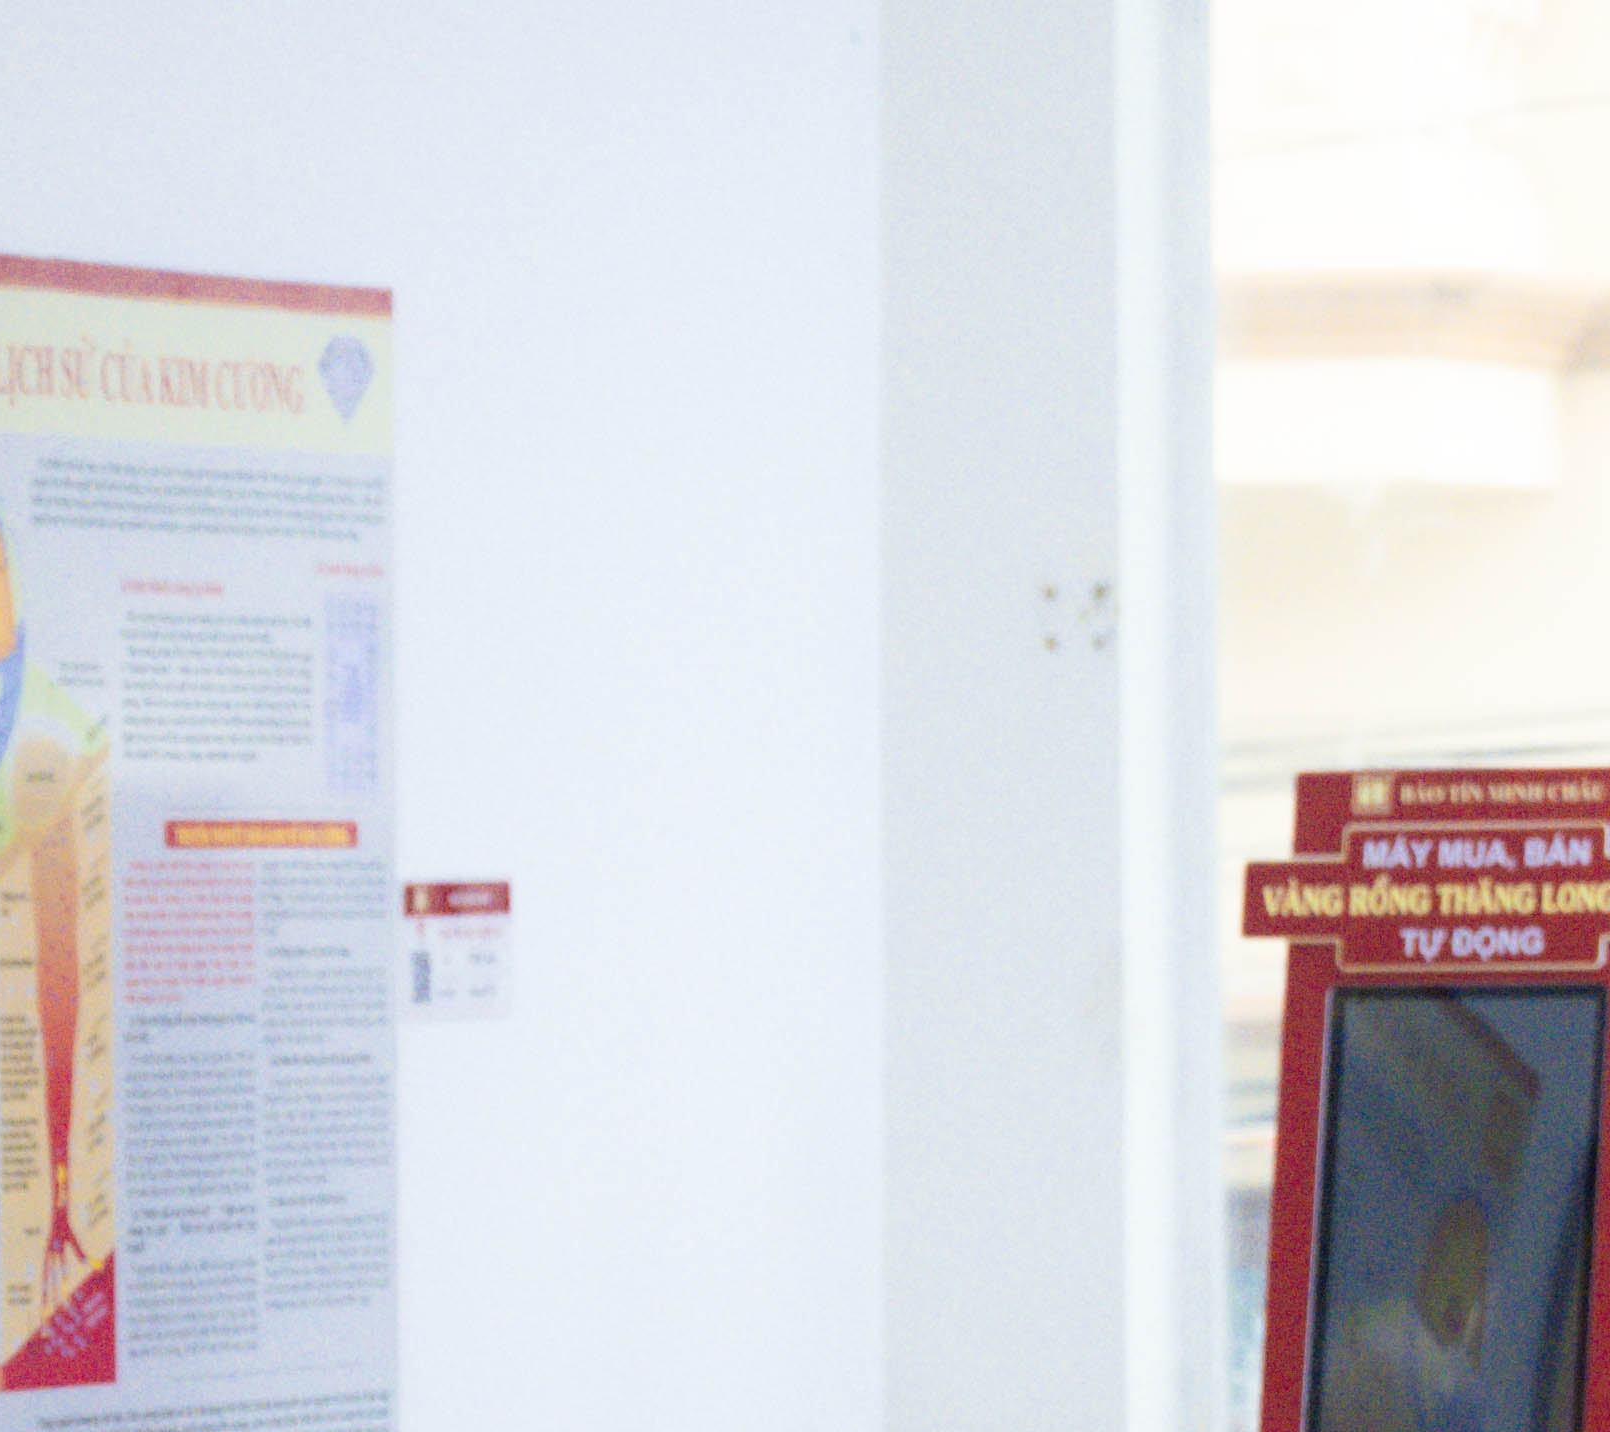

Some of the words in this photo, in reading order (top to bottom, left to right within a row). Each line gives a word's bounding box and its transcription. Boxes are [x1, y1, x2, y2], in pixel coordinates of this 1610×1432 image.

[1363, 835, 1433, 871] MÁY
[1439, 840, 1516, 871] MUA,
[1525, 830, 1593, 867] BÁN
[1263, 880, 1343, 917] VÀNG
[1400, 926, 1448, 963] TỰ
